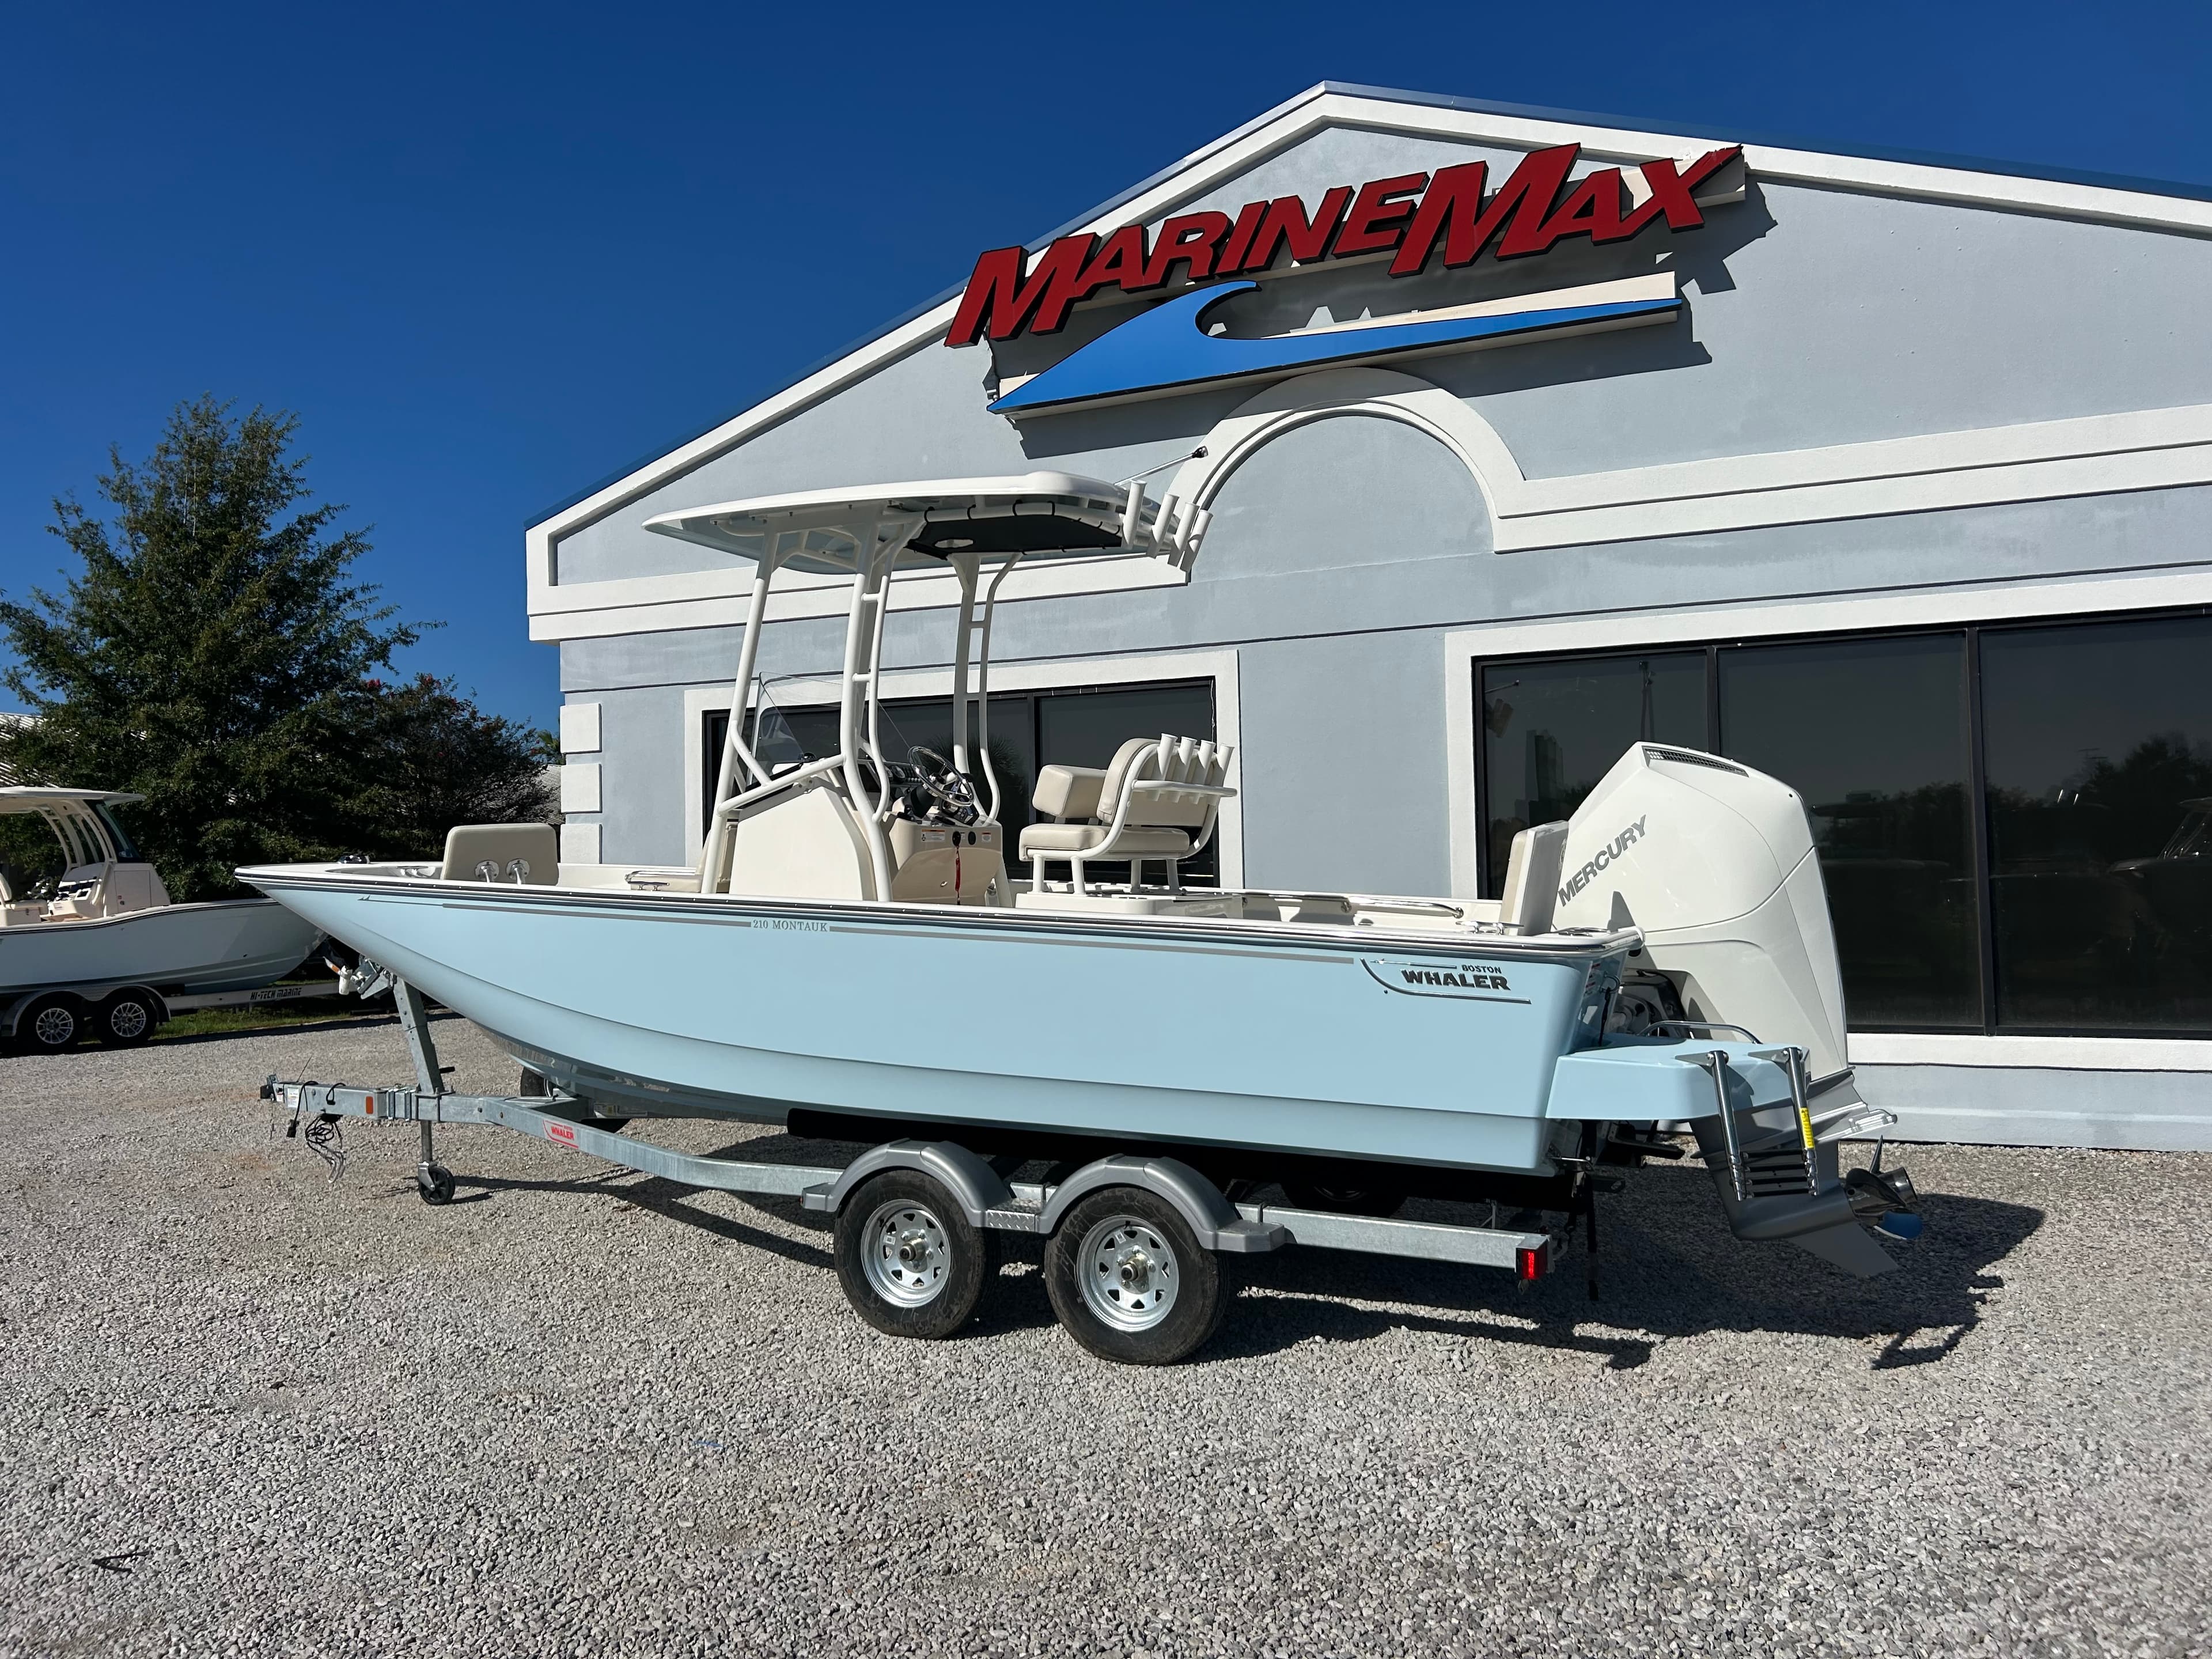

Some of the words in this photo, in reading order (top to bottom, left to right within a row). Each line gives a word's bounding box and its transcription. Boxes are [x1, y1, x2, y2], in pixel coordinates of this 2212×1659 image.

[1558, 814, 1646, 907] MERCURY
[753, 920, 768, 929] 210
[772, 921, 827, 931] MONTAUK
[1461, 964, 1502, 974] BOSTON
[1400, 969, 1511, 991] WHALER
[551, 1126, 574, 1141] WHALER
